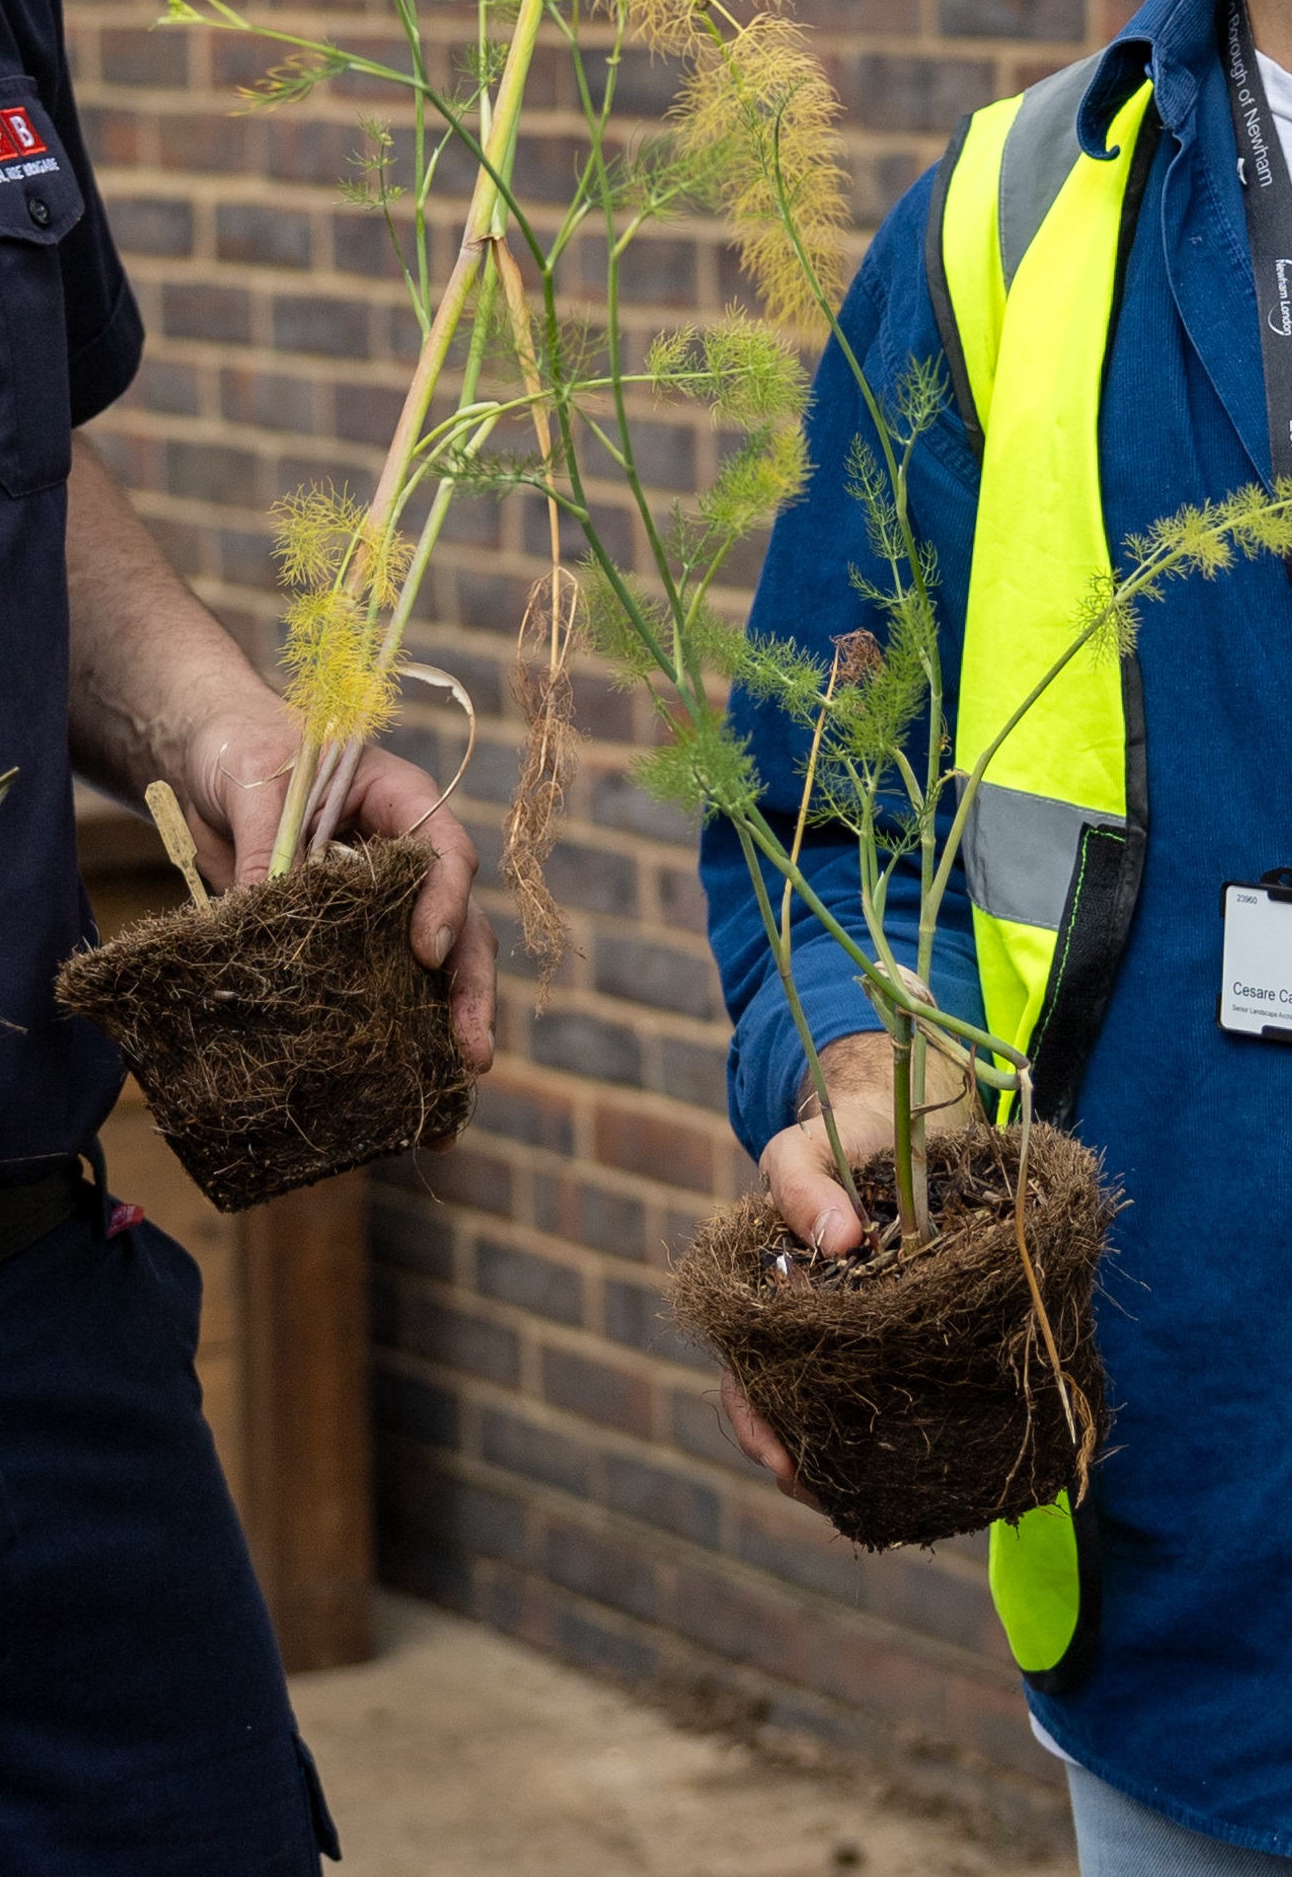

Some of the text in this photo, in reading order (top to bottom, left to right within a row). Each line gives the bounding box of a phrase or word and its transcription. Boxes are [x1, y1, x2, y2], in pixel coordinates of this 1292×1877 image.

[1237, 88, 1256, 109] of
[1245, 106, 1273, 189] Newham
[1274, 258, 1292, 337] Newham London
[1232, 981, 1276, 1001] Cesare
[1231, 1003, 1249, 1013] Senior
[1249, 1007, 1278, 1019] Landscape
